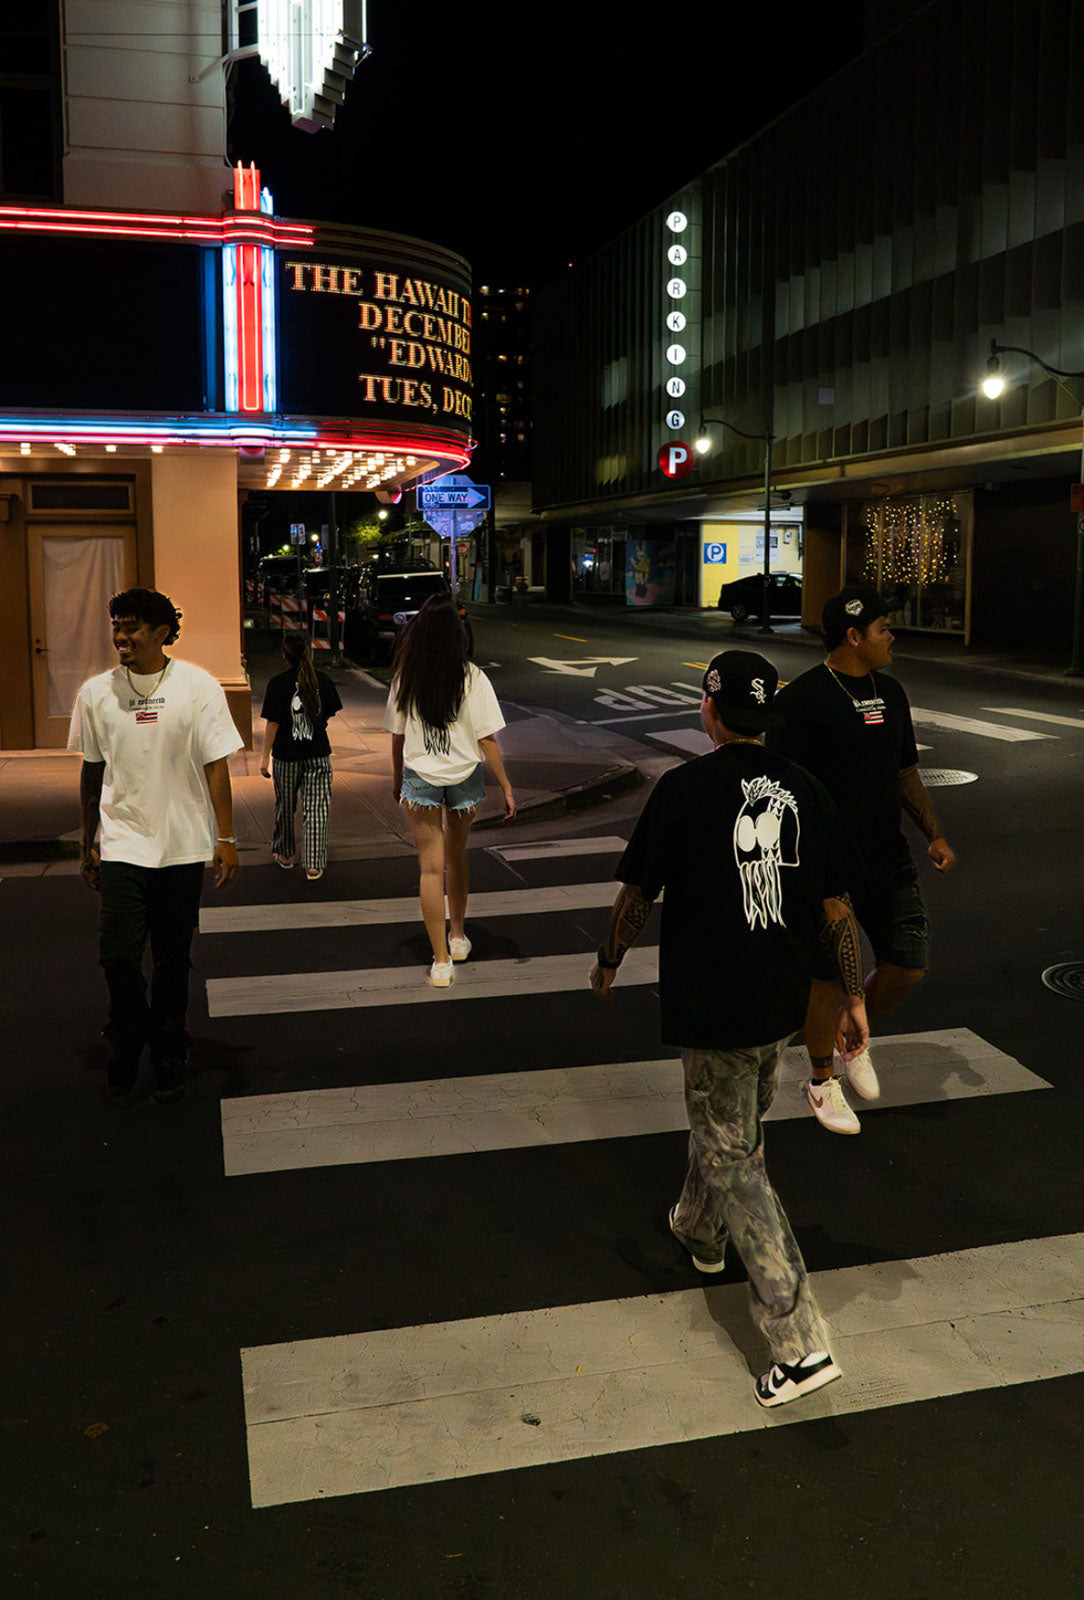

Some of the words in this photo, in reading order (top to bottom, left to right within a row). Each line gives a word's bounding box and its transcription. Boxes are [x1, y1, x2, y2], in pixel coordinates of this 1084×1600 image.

[285, 261, 364, 296] THE
[373, 271, 460, 318] HAWAII
[669, 214, 683, 428] PARKING
[370, 335, 474, 387] "EDWARD
[358, 373, 438, 416] TUES,
[668, 446, 688, 475] P
[424, 493, 444, 503] ONE
[448, 493, 468, 503] WAY
[710, 545, 722, 559] P
